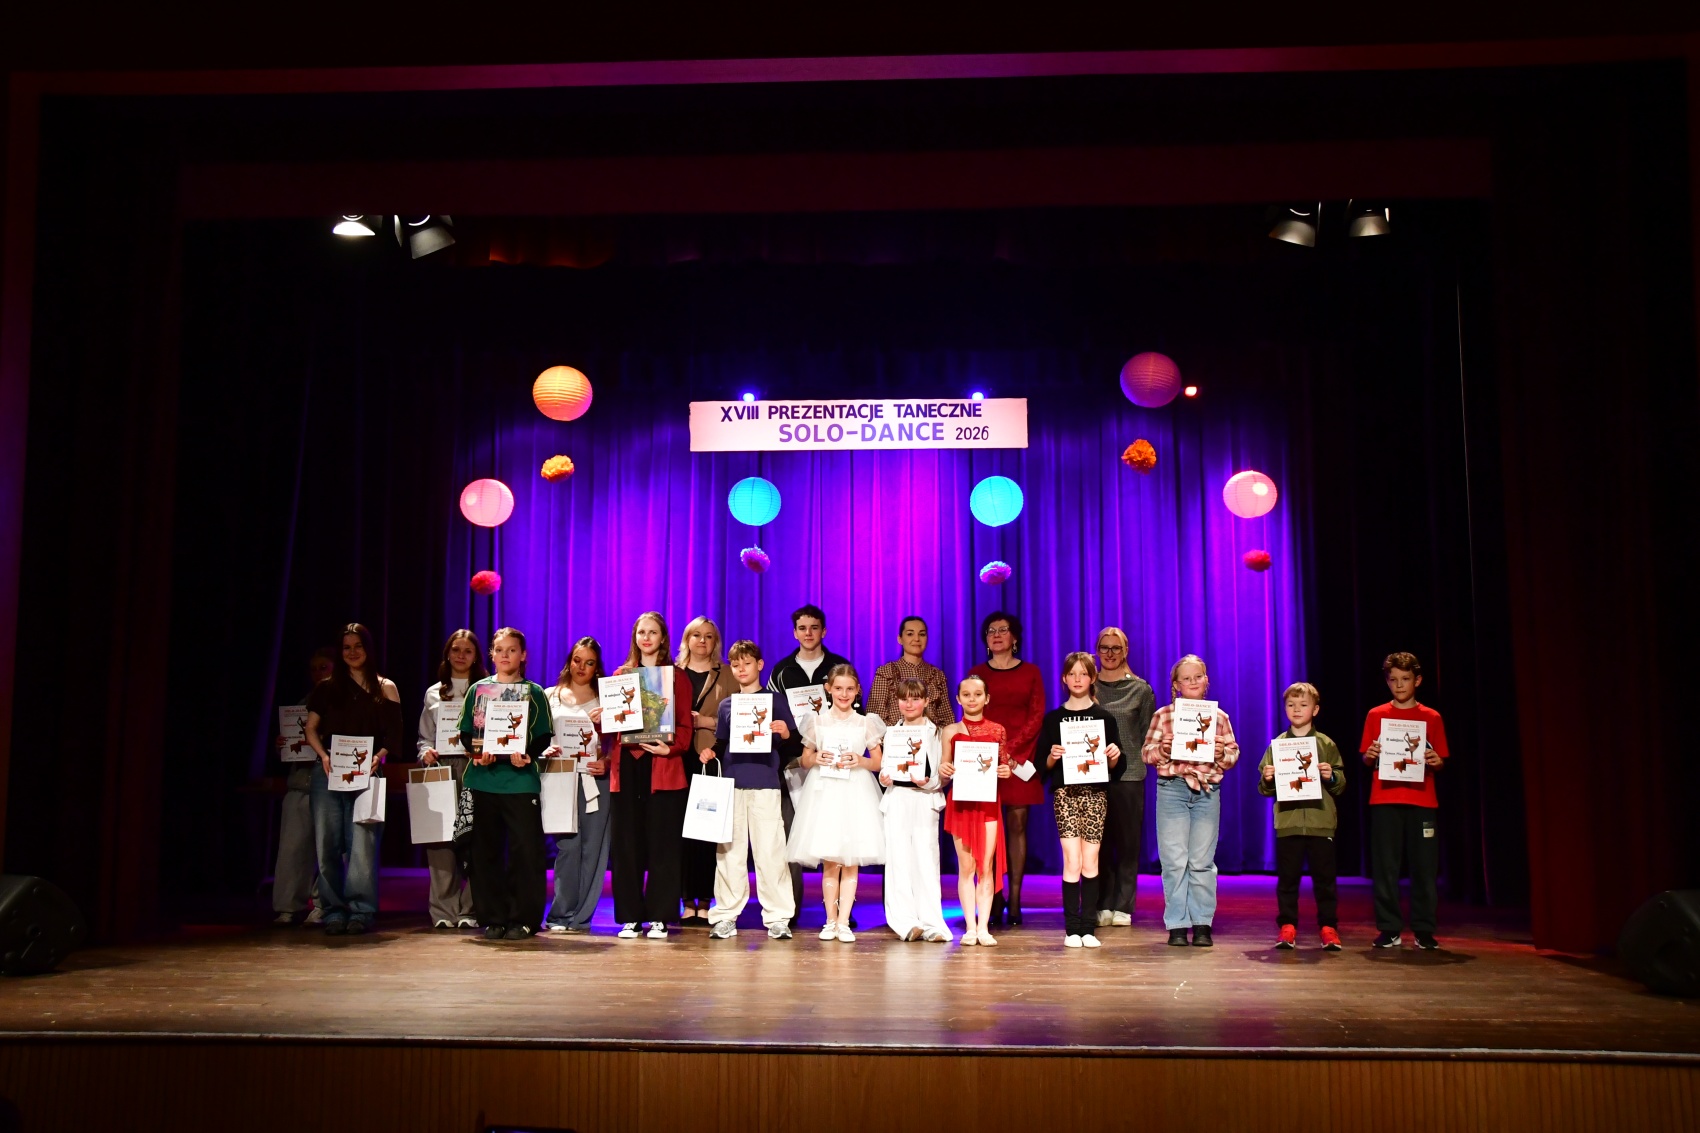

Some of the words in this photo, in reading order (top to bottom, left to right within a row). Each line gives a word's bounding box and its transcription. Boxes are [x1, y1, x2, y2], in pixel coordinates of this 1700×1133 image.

[720, 405, 760, 422] XVIII
[768, 403, 884, 422] PREZENTACJE
[893, 402, 983, 419] TANECZNE
[779, 422, 945, 443] SOLO-DANCE
[955, 425, 989, 441] 2026
